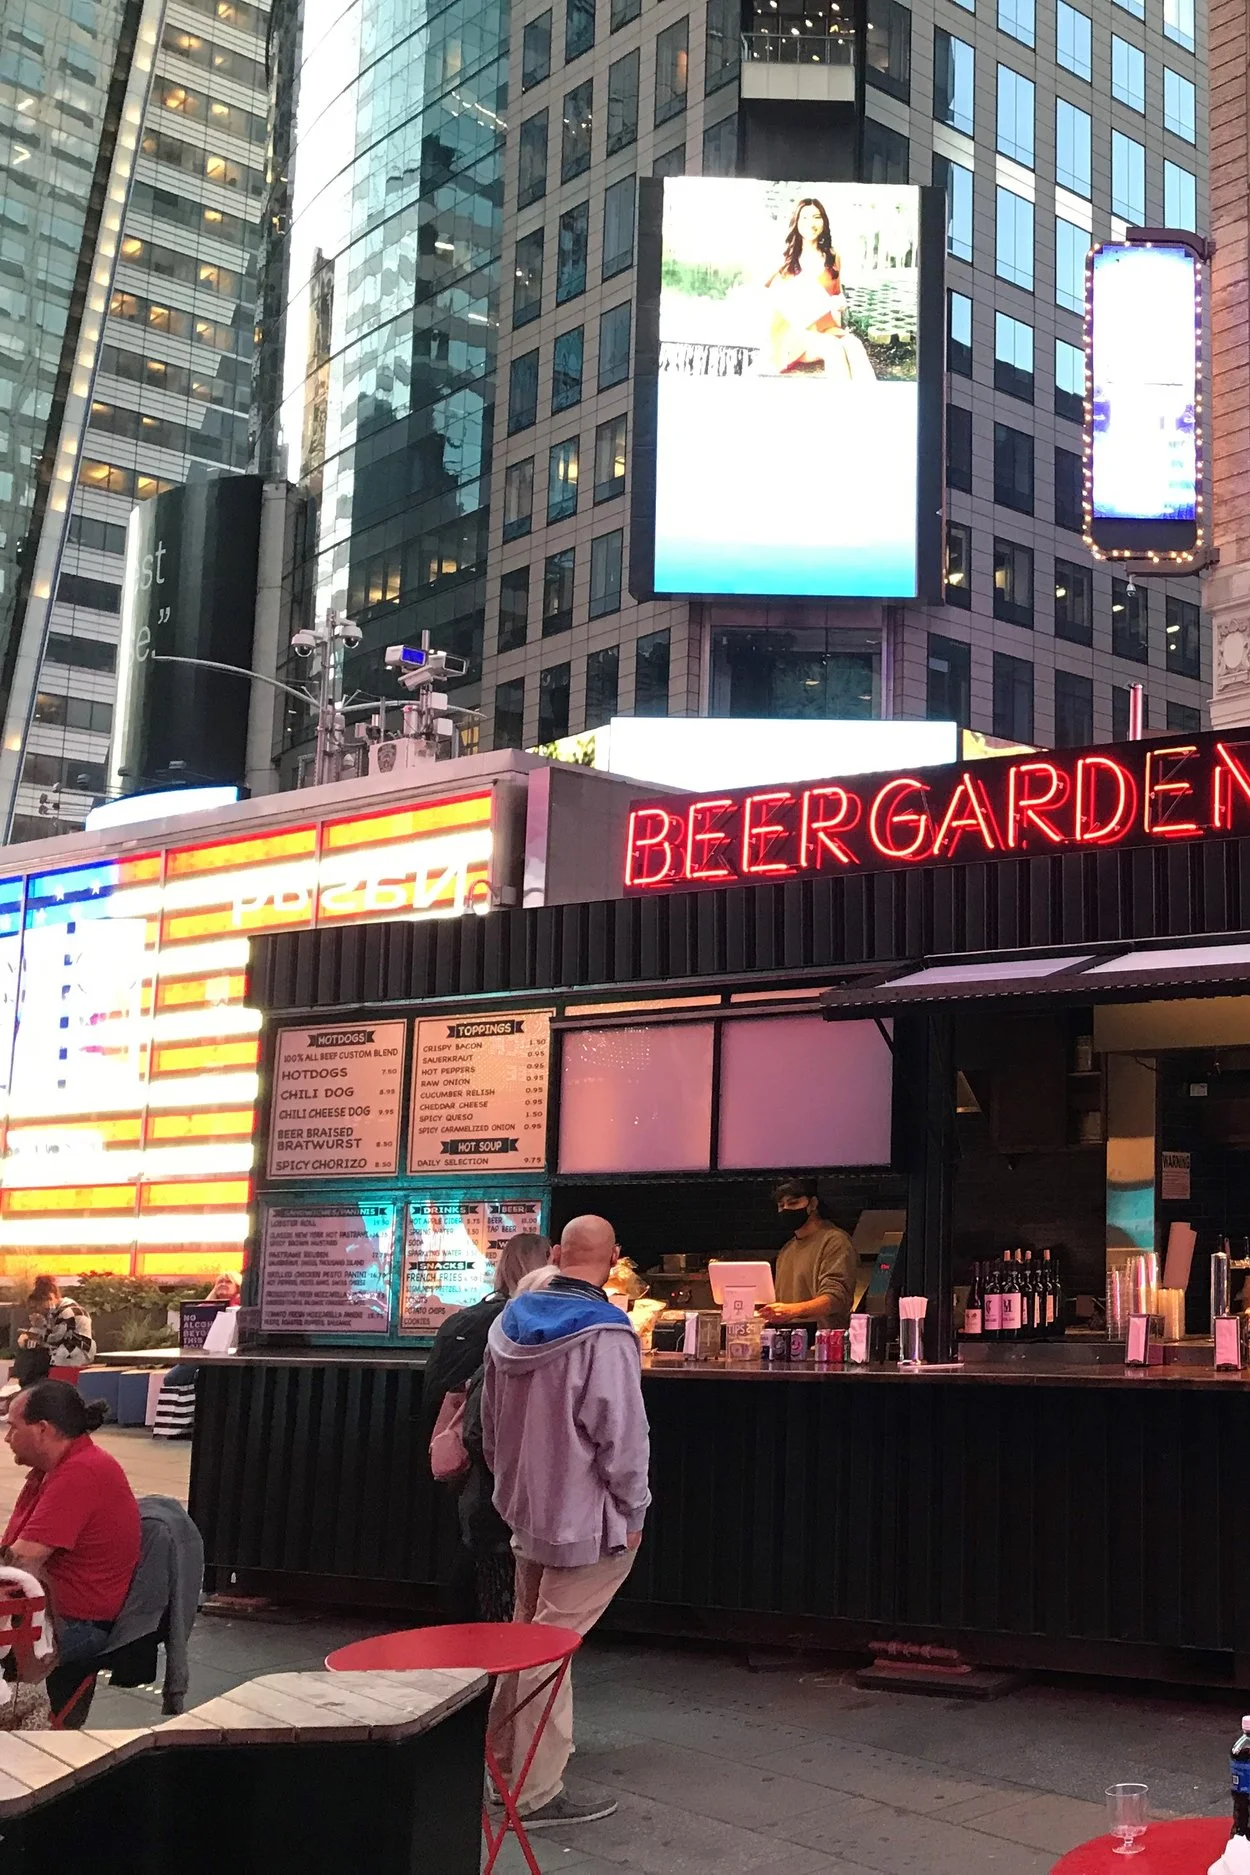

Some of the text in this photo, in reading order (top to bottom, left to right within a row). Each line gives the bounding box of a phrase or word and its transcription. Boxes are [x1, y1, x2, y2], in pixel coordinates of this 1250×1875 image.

[458, 1023, 512, 1036] TOPPINGS
[318, 1033, 365, 1045] HOTDOGS
[423, 1044, 452, 1053] CRISPY
[455, 1042, 483, 1051] BACON
[284, 1048, 398, 1063] 100% ALL BEEF CUSTOM BLEND
[422, 1054, 474, 1064] SAUERKRAUT
[282, 1067, 348, 1080] HOTDOGS
[421, 1068, 438, 1076] HOT
[440, 1066, 476, 1075] PEPPERS
[443, 1078, 471, 1087] ONION
[280, 1089, 319, 1100] CHILI
[324, 1087, 355, 1098] DOG
[420, 1090, 463, 1099] CUCUMBER
[466, 1088, 496, 1097] RELISH
[419, 1102, 456, 1111] CHEDDAR
[458, 1101, 489, 1109] CHEESE
[279, 1109, 307, 1120] CHILI
[308, 1107, 346, 1119] CHEESE
[348, 1105, 371, 1117] DOG
[419, 1114, 443, 1123] SPICY
[445, 1113, 474, 1122] QUESO
[277, 1127, 354, 1139] BEER BRAISED
[418, 1126, 439, 1134] SPICY
[440, 1124, 490, 1133] CARAMELIZED
[491, 1123, 516, 1131] ONION
[277, 1138, 362, 1151] BRATWURST
[458, 1140, 502, 1153] HOT SOUP
[275, 1160, 310, 1171] SPICY
[312, 1158, 368, 1170] CHORIZO
[417, 1159, 441, 1167] DAILY
[444, 1158, 489, 1166] SELECTION
[423, 1206, 467, 1214] DRINKS
[487, 1216, 503, 1224] BEER
[501, 1224, 517, 1233] BEER
[419, 1261, 465, 1270] SNACKS
[344, 1270, 367, 1279] PANINI
[406, 1273, 437, 1282] FRENCH
[439, 1272, 463, 1282] FRIES
[183, 1314, 197, 1322] NO
[183, 1321, 214, 1329] ALCOH
